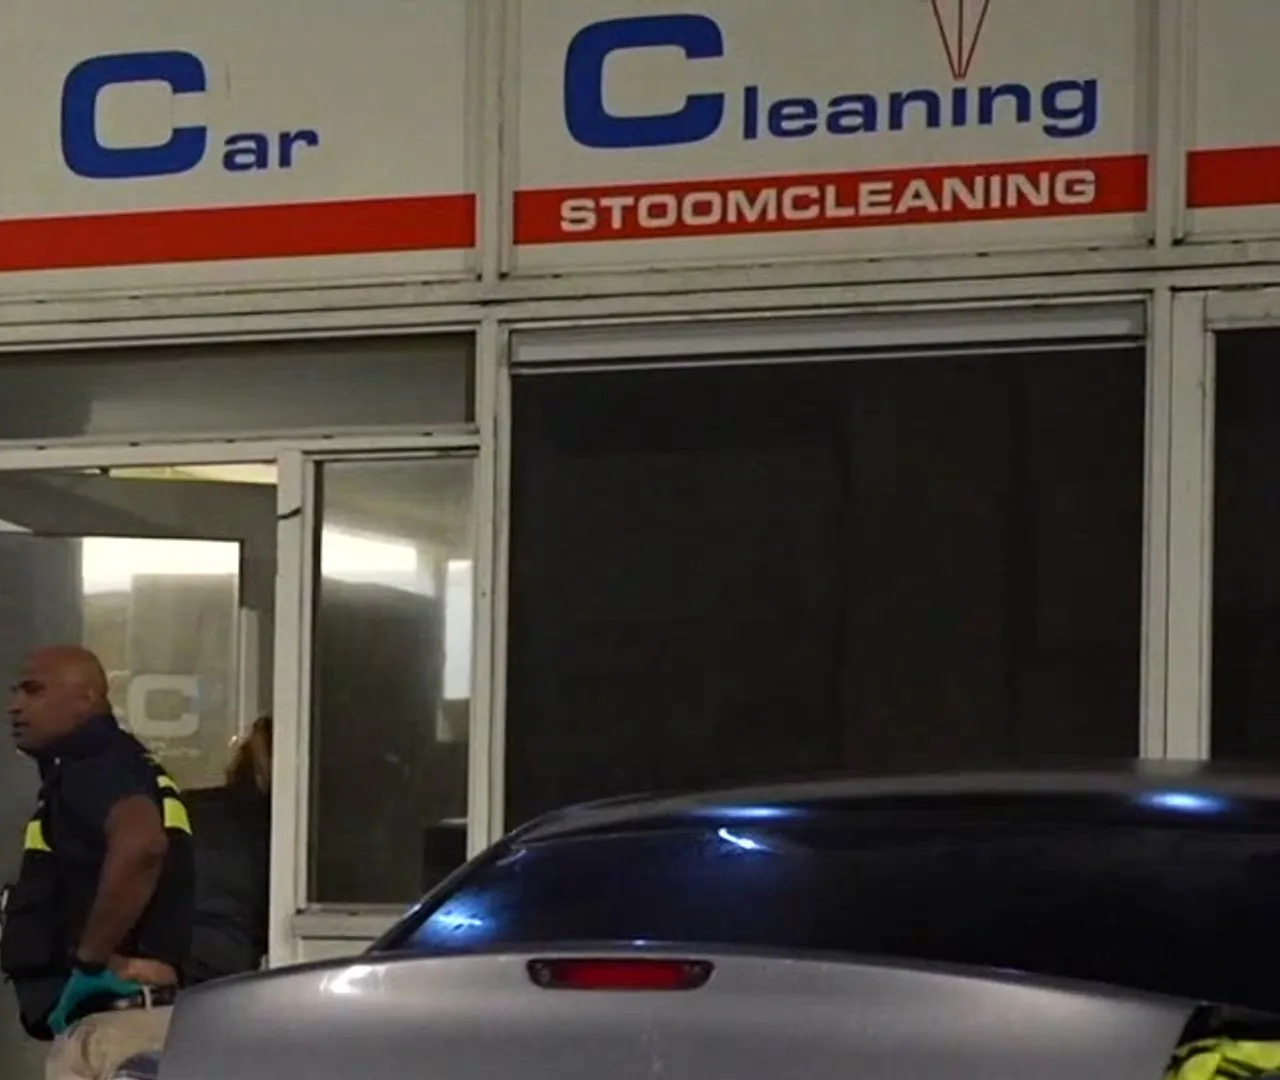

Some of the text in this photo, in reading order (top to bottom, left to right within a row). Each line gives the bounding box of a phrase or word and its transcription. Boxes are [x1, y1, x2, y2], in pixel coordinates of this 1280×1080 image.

[60, 13, 1098, 179] Car Cleaning
[560, 168, 1097, 233] STOOMCLEANING
